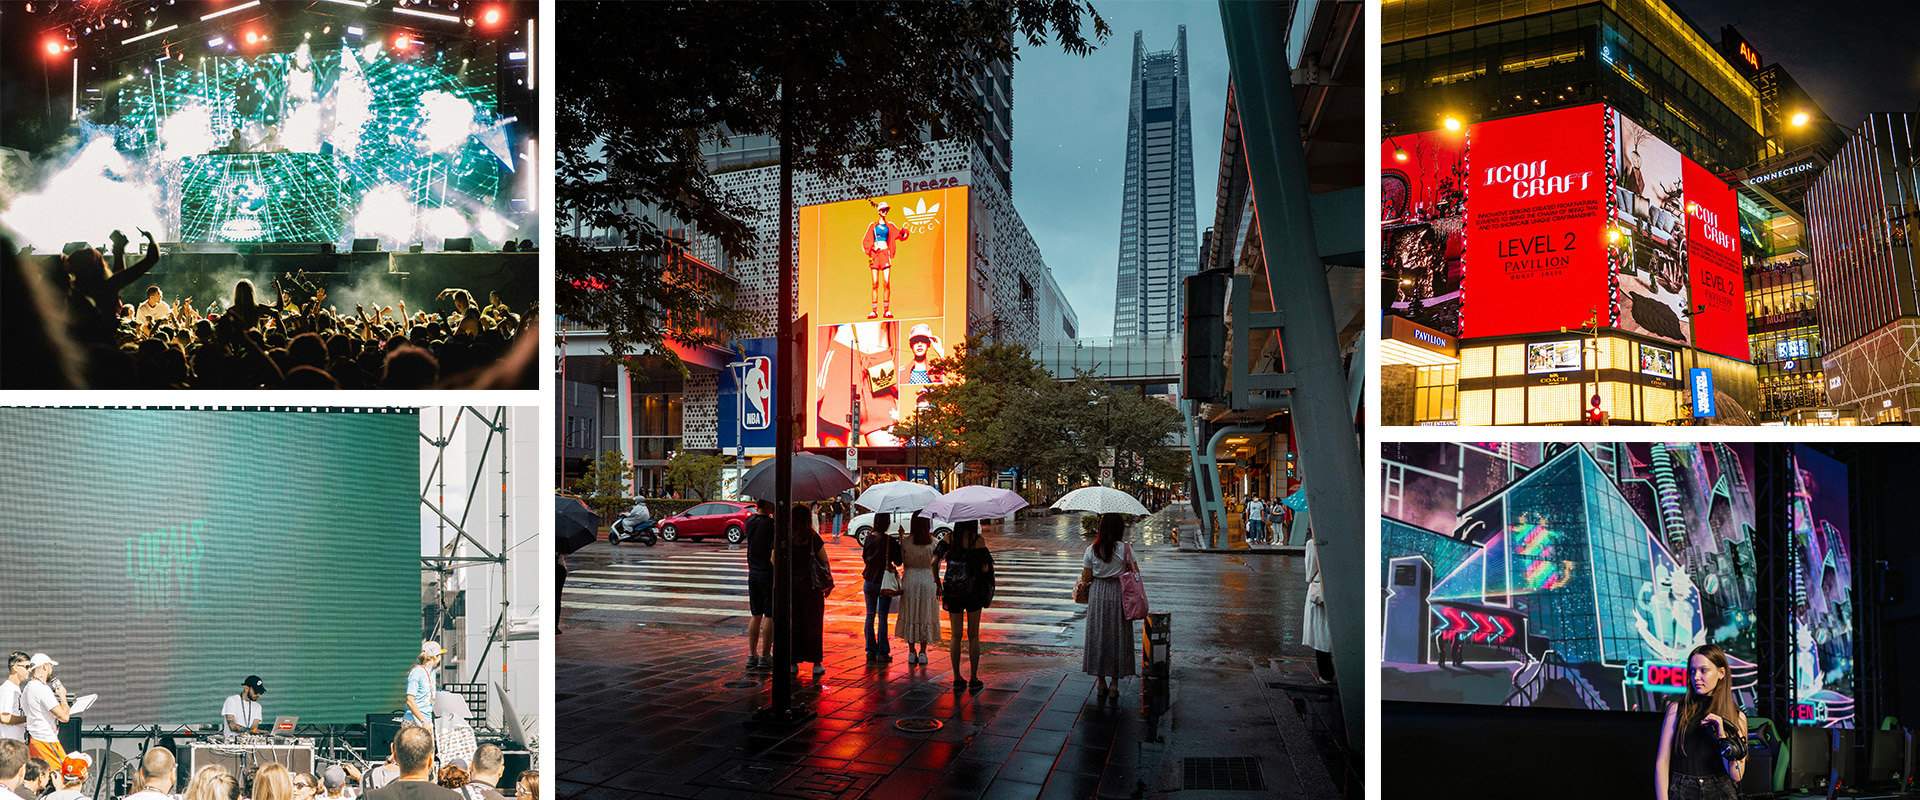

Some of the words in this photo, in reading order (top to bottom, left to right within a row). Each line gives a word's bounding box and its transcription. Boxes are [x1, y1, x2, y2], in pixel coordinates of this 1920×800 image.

[1740, 42, 1759, 70] AIA
[902, 176, 959, 193] Breeze
[1483, 160, 1547, 186] ICON
[1749, 162, 1814, 185] CONNECTION
[1513, 172, 1594, 199] CRAFT
[902, 218, 941, 234] GUCCI
[1704, 223, 1736, 252] CRAFT
[1499, 235, 1557, 258] LEVEL
[1564, 232, 1576, 251] 2
[1505, 256, 1569, 272] PAVILION
[1701, 269, 1726, 293] LEVEL
[1728, 281, 1735, 296] 2
[1767, 313, 1786, 325] MUJI
[1414, 329, 1446, 348] PAVILION
[1540, 376, 1568, 384] COACH
[746, 412, 761, 425] NBA
[126, 518, 205, 580] LOCALS
